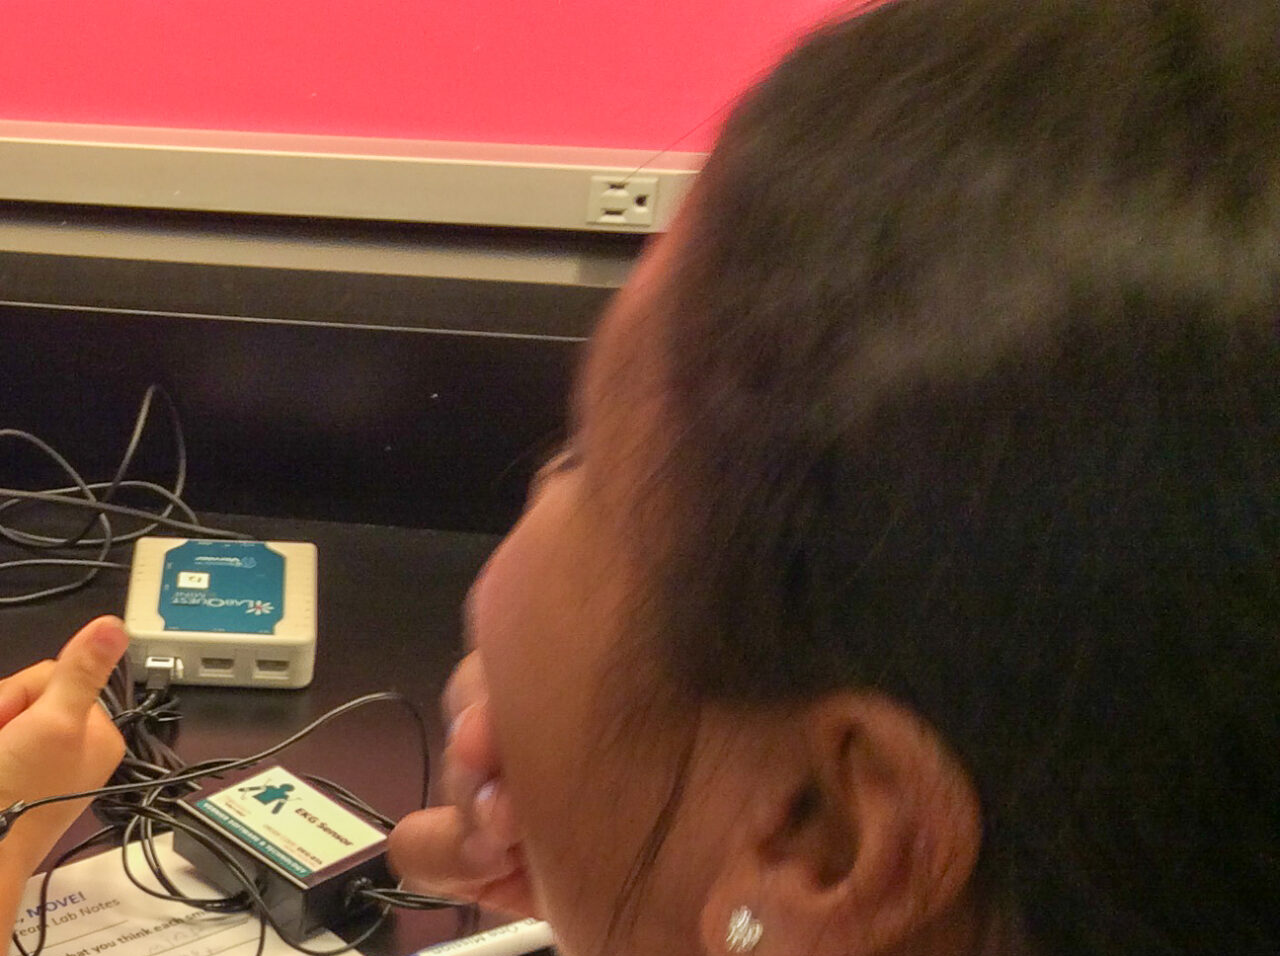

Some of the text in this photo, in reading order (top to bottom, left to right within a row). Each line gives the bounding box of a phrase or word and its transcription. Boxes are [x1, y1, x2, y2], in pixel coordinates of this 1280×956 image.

[295, 808, 318, 823] EKG
[317, 820, 354, 846] Sensor
[51, 912, 78, 927] Lab
[80, 899, 121, 917] Notes
[91, 941, 117, 954] you
[118, 929, 153, 948] think
